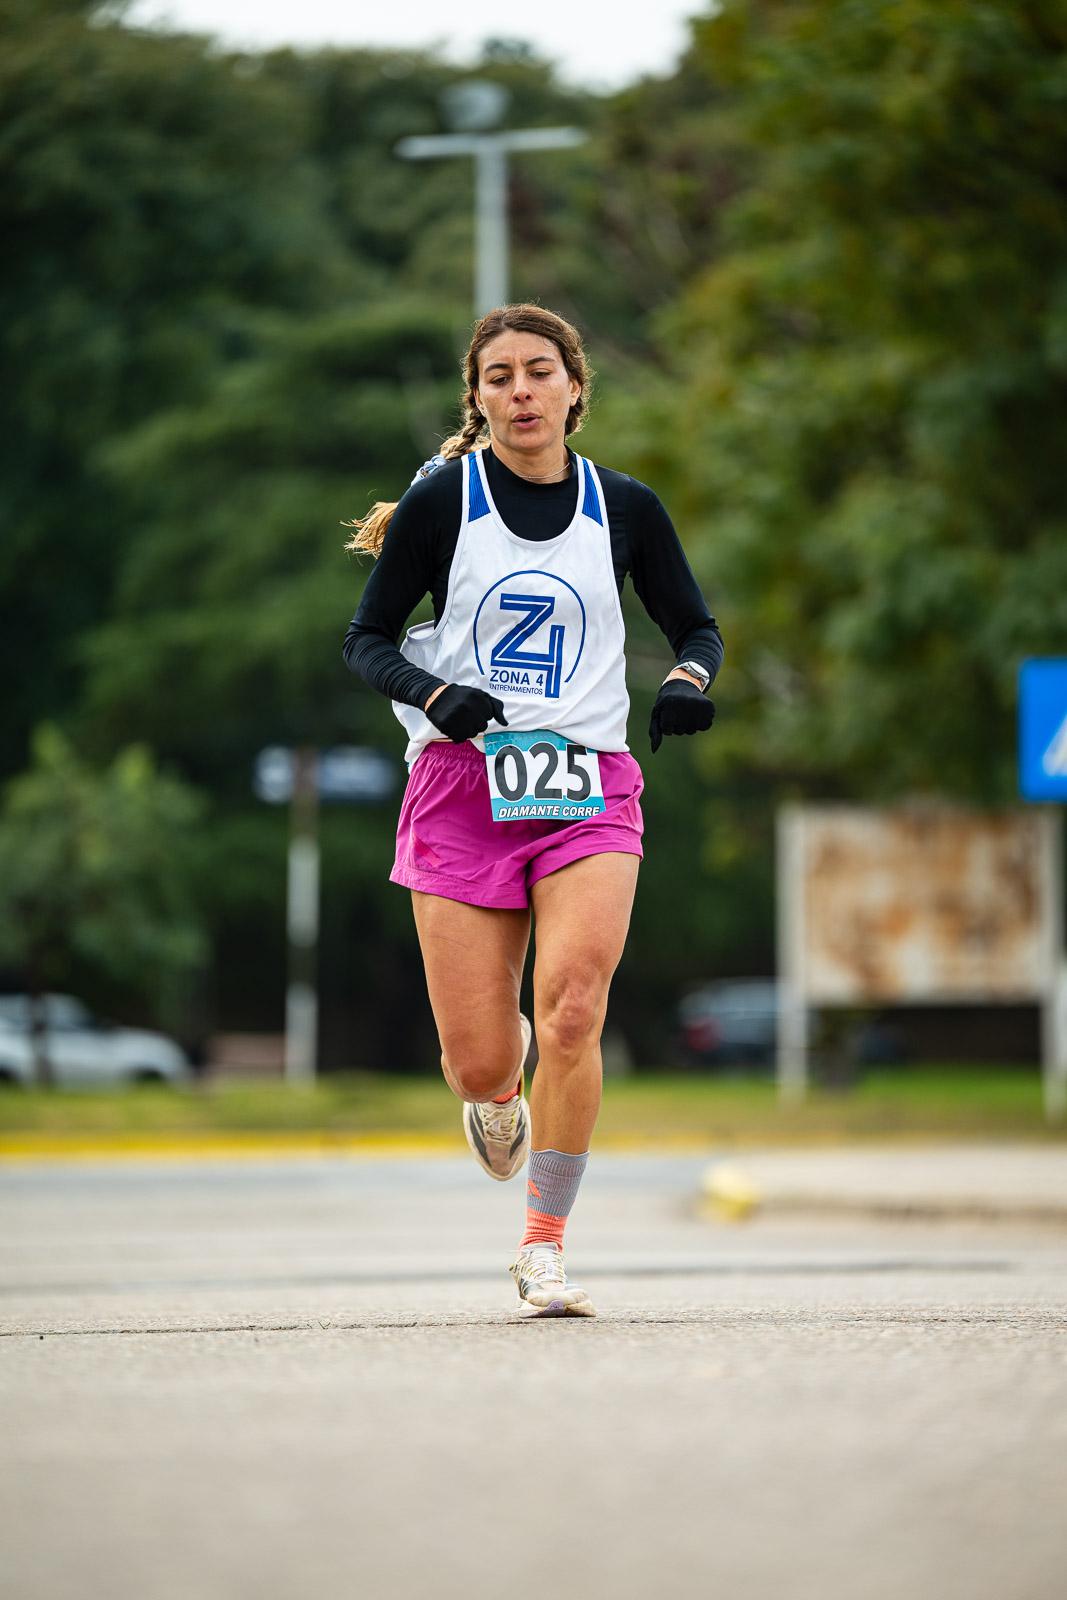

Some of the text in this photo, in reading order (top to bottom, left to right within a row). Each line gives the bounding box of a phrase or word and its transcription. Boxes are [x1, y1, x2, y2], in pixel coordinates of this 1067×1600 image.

[490, 669, 544, 686] ZONA 4
[489, 683, 543, 695] ENTRENAMIENTOS
[494, 741, 591, 802] 025
[498, 805, 600, 819] DIAMANTE CORRE
